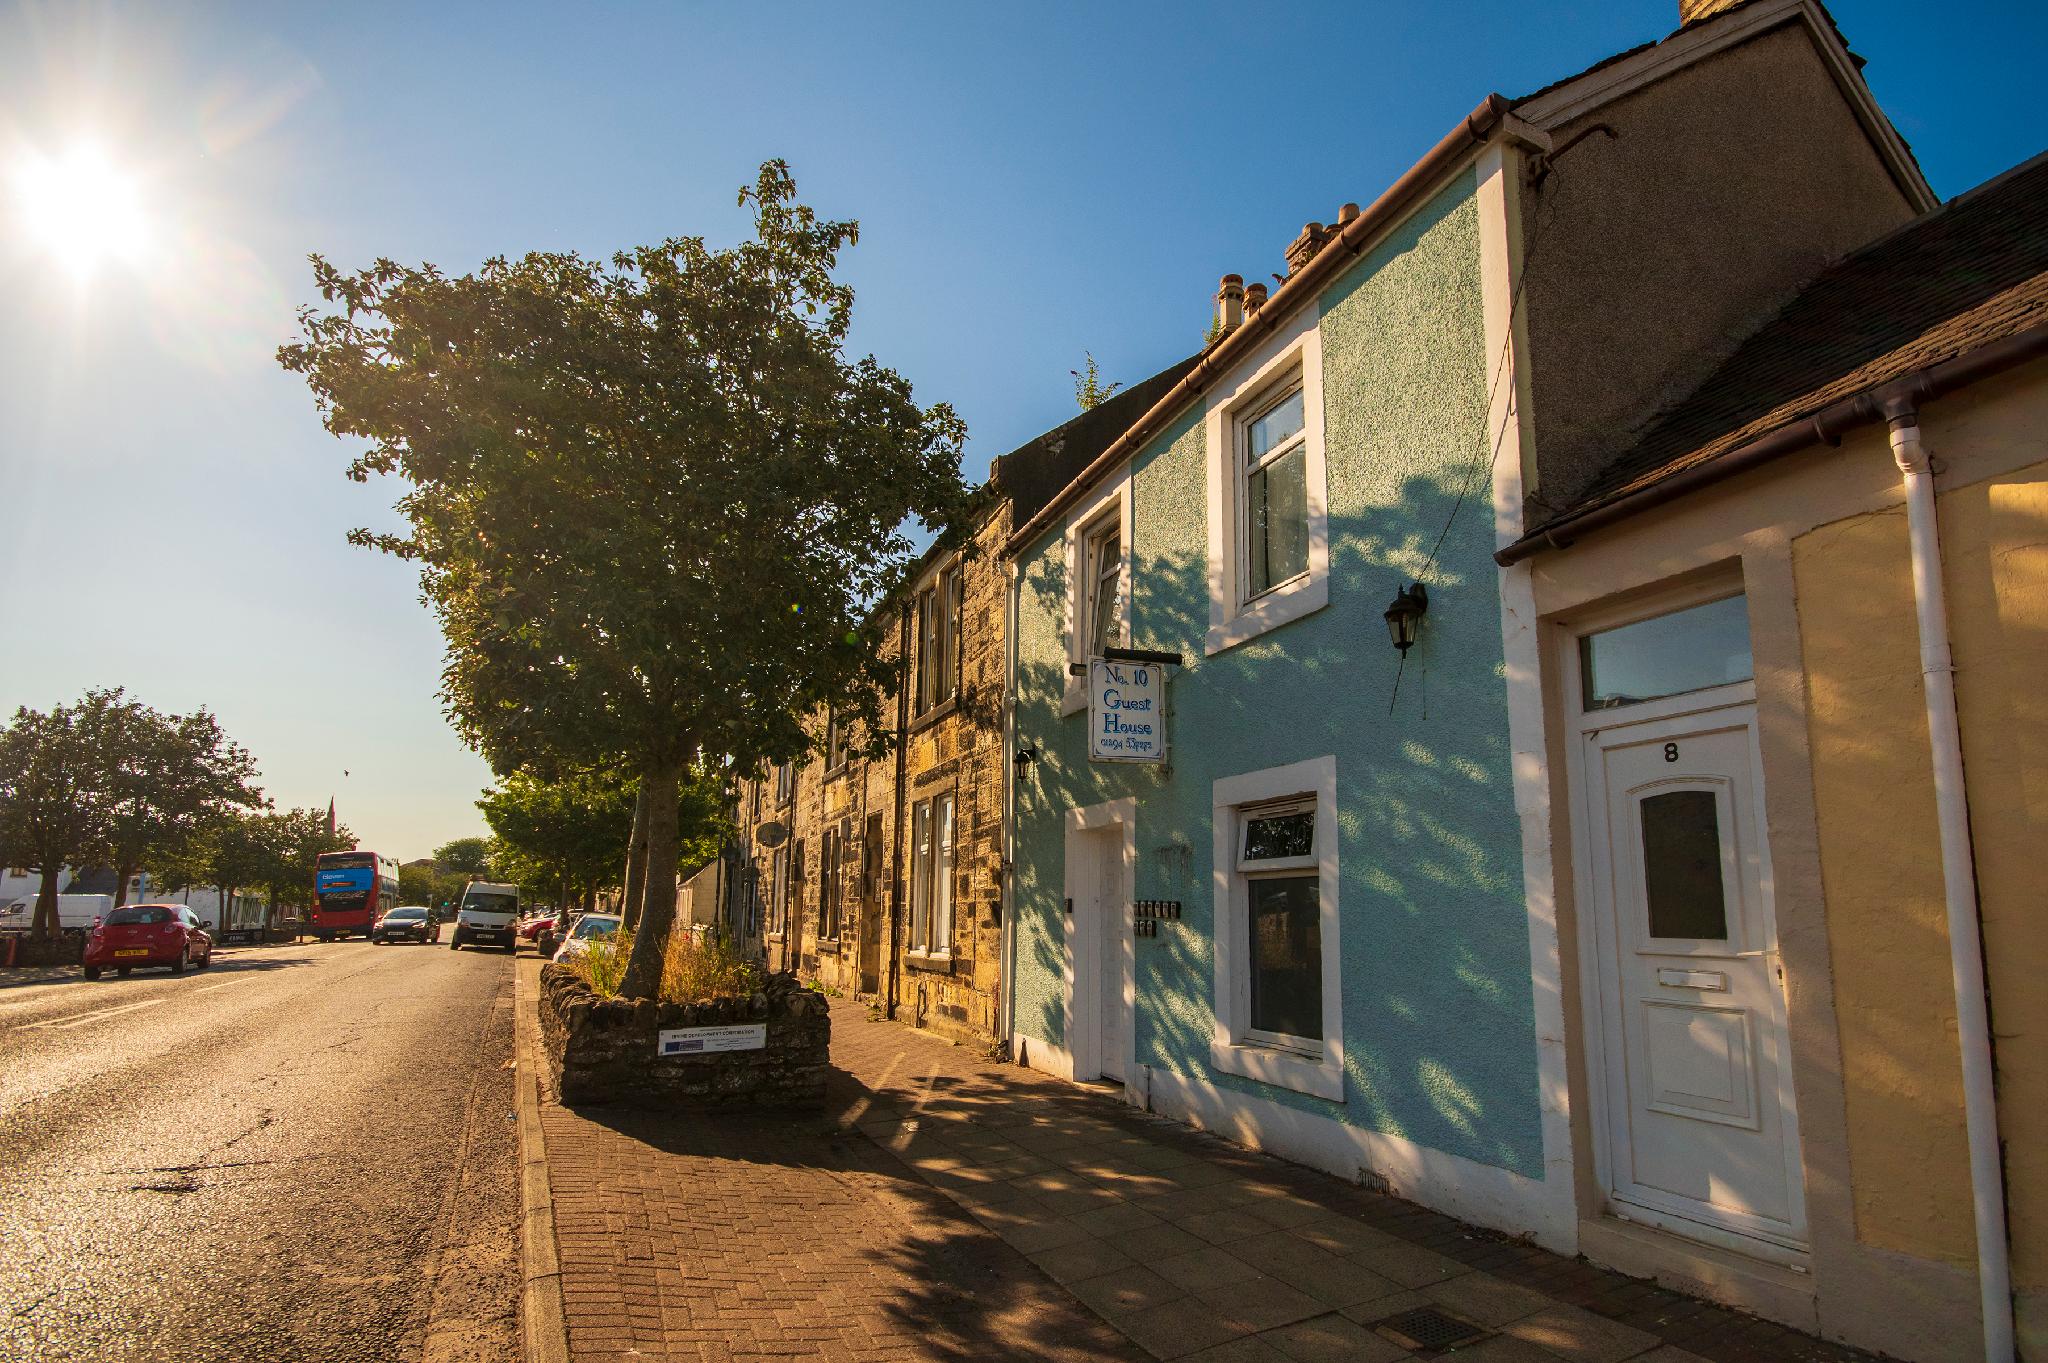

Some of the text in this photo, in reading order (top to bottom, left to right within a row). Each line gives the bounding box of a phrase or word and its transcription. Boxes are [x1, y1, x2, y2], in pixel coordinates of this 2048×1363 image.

[1105, 665, 1148, 687] No. 10
[1103, 688, 1152, 710] Guest
[1102, 712, 1153, 735] House
[1664, 742, 1679, 763] 8
